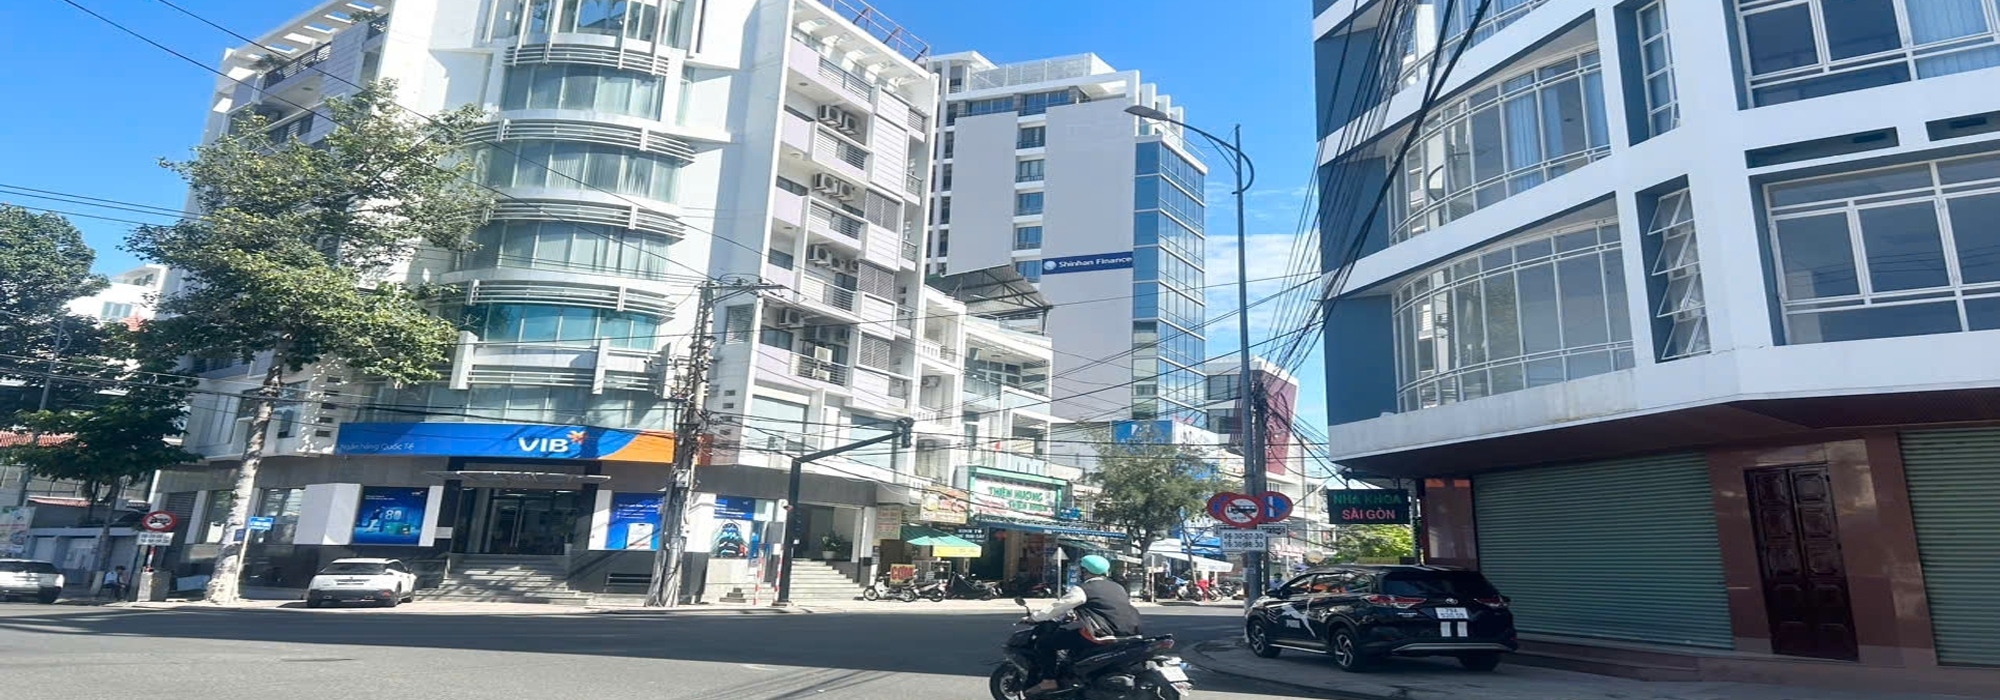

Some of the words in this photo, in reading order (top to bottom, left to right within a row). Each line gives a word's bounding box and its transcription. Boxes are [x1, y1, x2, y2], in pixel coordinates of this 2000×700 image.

[1058, 259, 1094, 268] Shinhan
[1095, 257, 1132, 265] Finance
[381, 442, 402, 451] Quốc
[518, 437, 569, 453] VIB
[1333, 494, 1360, 505] NHA
[1365, 494, 1401, 505] KHOA
[1342, 507, 1363, 519] SÀI
[1366, 507, 1396, 519] GÒN
